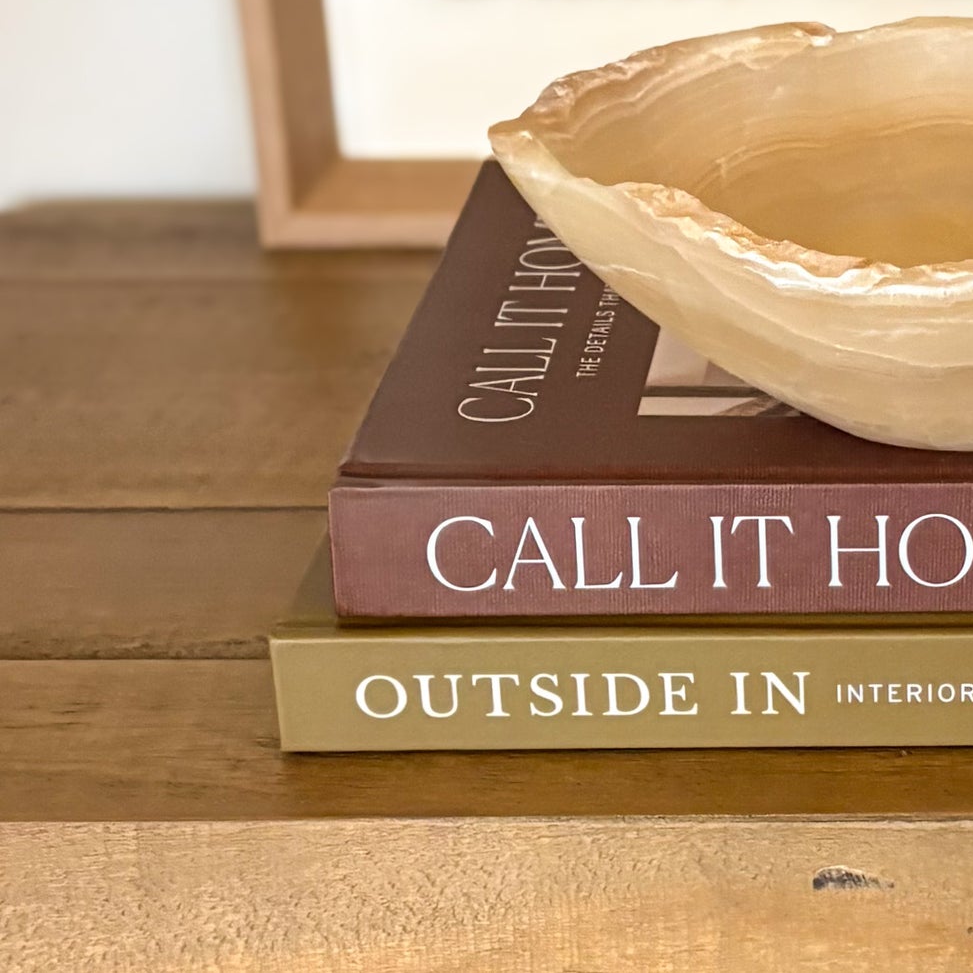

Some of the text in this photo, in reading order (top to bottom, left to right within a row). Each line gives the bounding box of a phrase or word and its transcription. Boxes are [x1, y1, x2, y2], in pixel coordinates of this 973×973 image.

[457, 214, 583, 423] CALL IT HO
[584, 310, 616, 353] DETAILS
[576, 358, 601, 377] THE
[426, 515, 679, 592] CALL
[709, 515, 794, 588] IT
[355, 671, 810, 719] OUTSIDE IN
